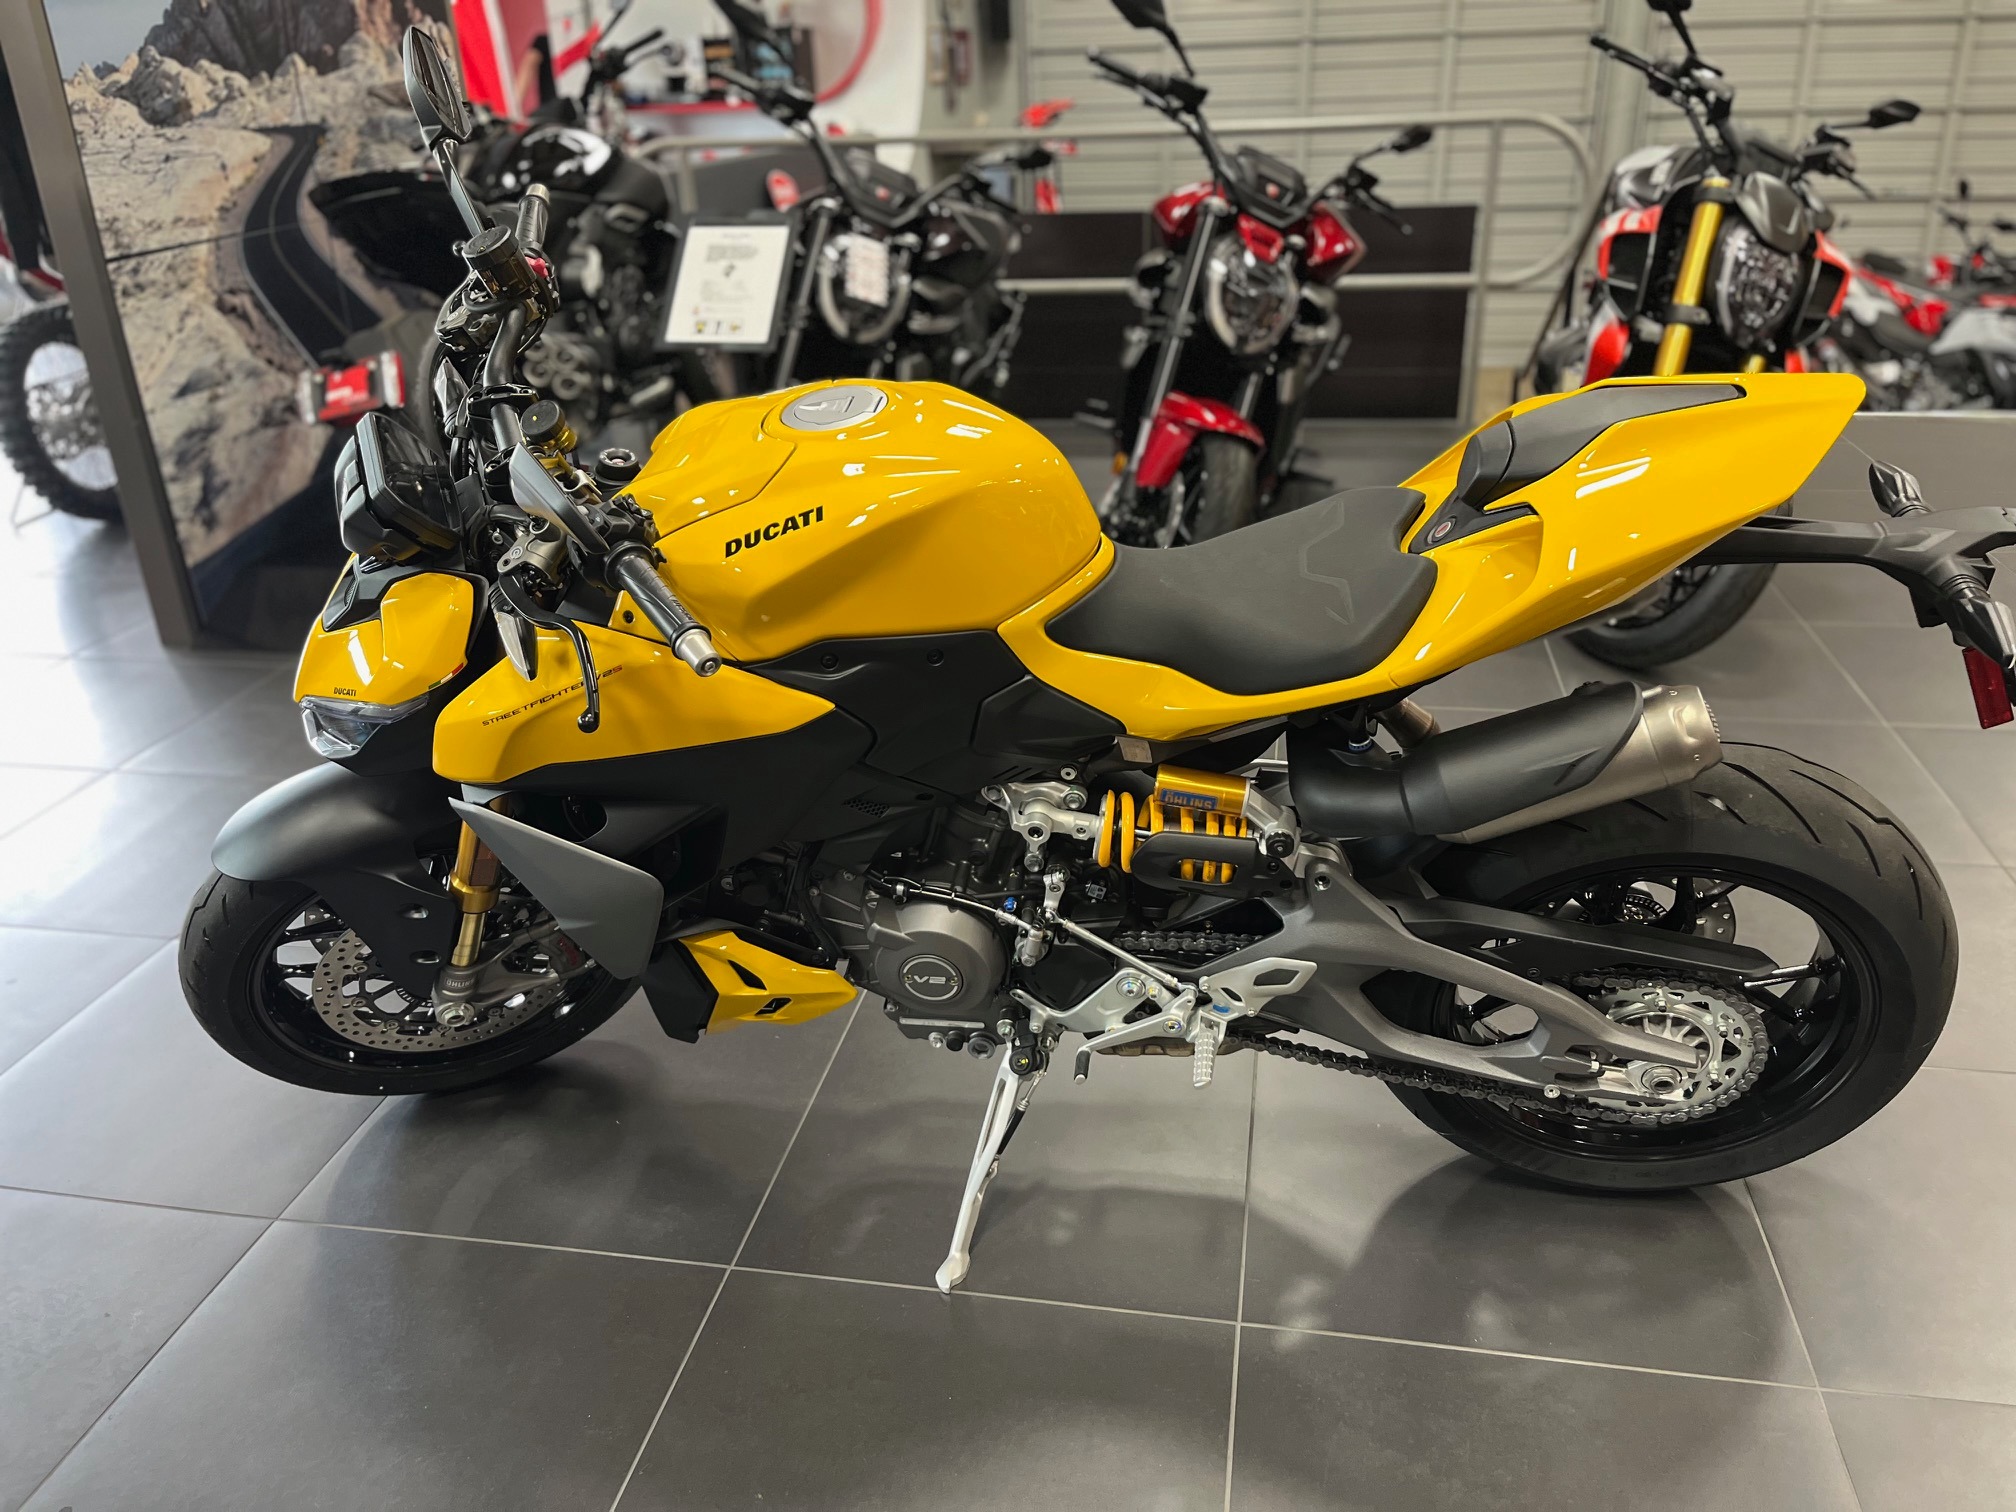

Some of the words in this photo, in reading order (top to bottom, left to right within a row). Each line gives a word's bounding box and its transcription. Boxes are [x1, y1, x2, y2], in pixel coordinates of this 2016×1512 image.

[725, 505, 823, 558] DUCATI
[333, 687, 357, 697] DUCATI
[913, 975, 946, 984] V2
